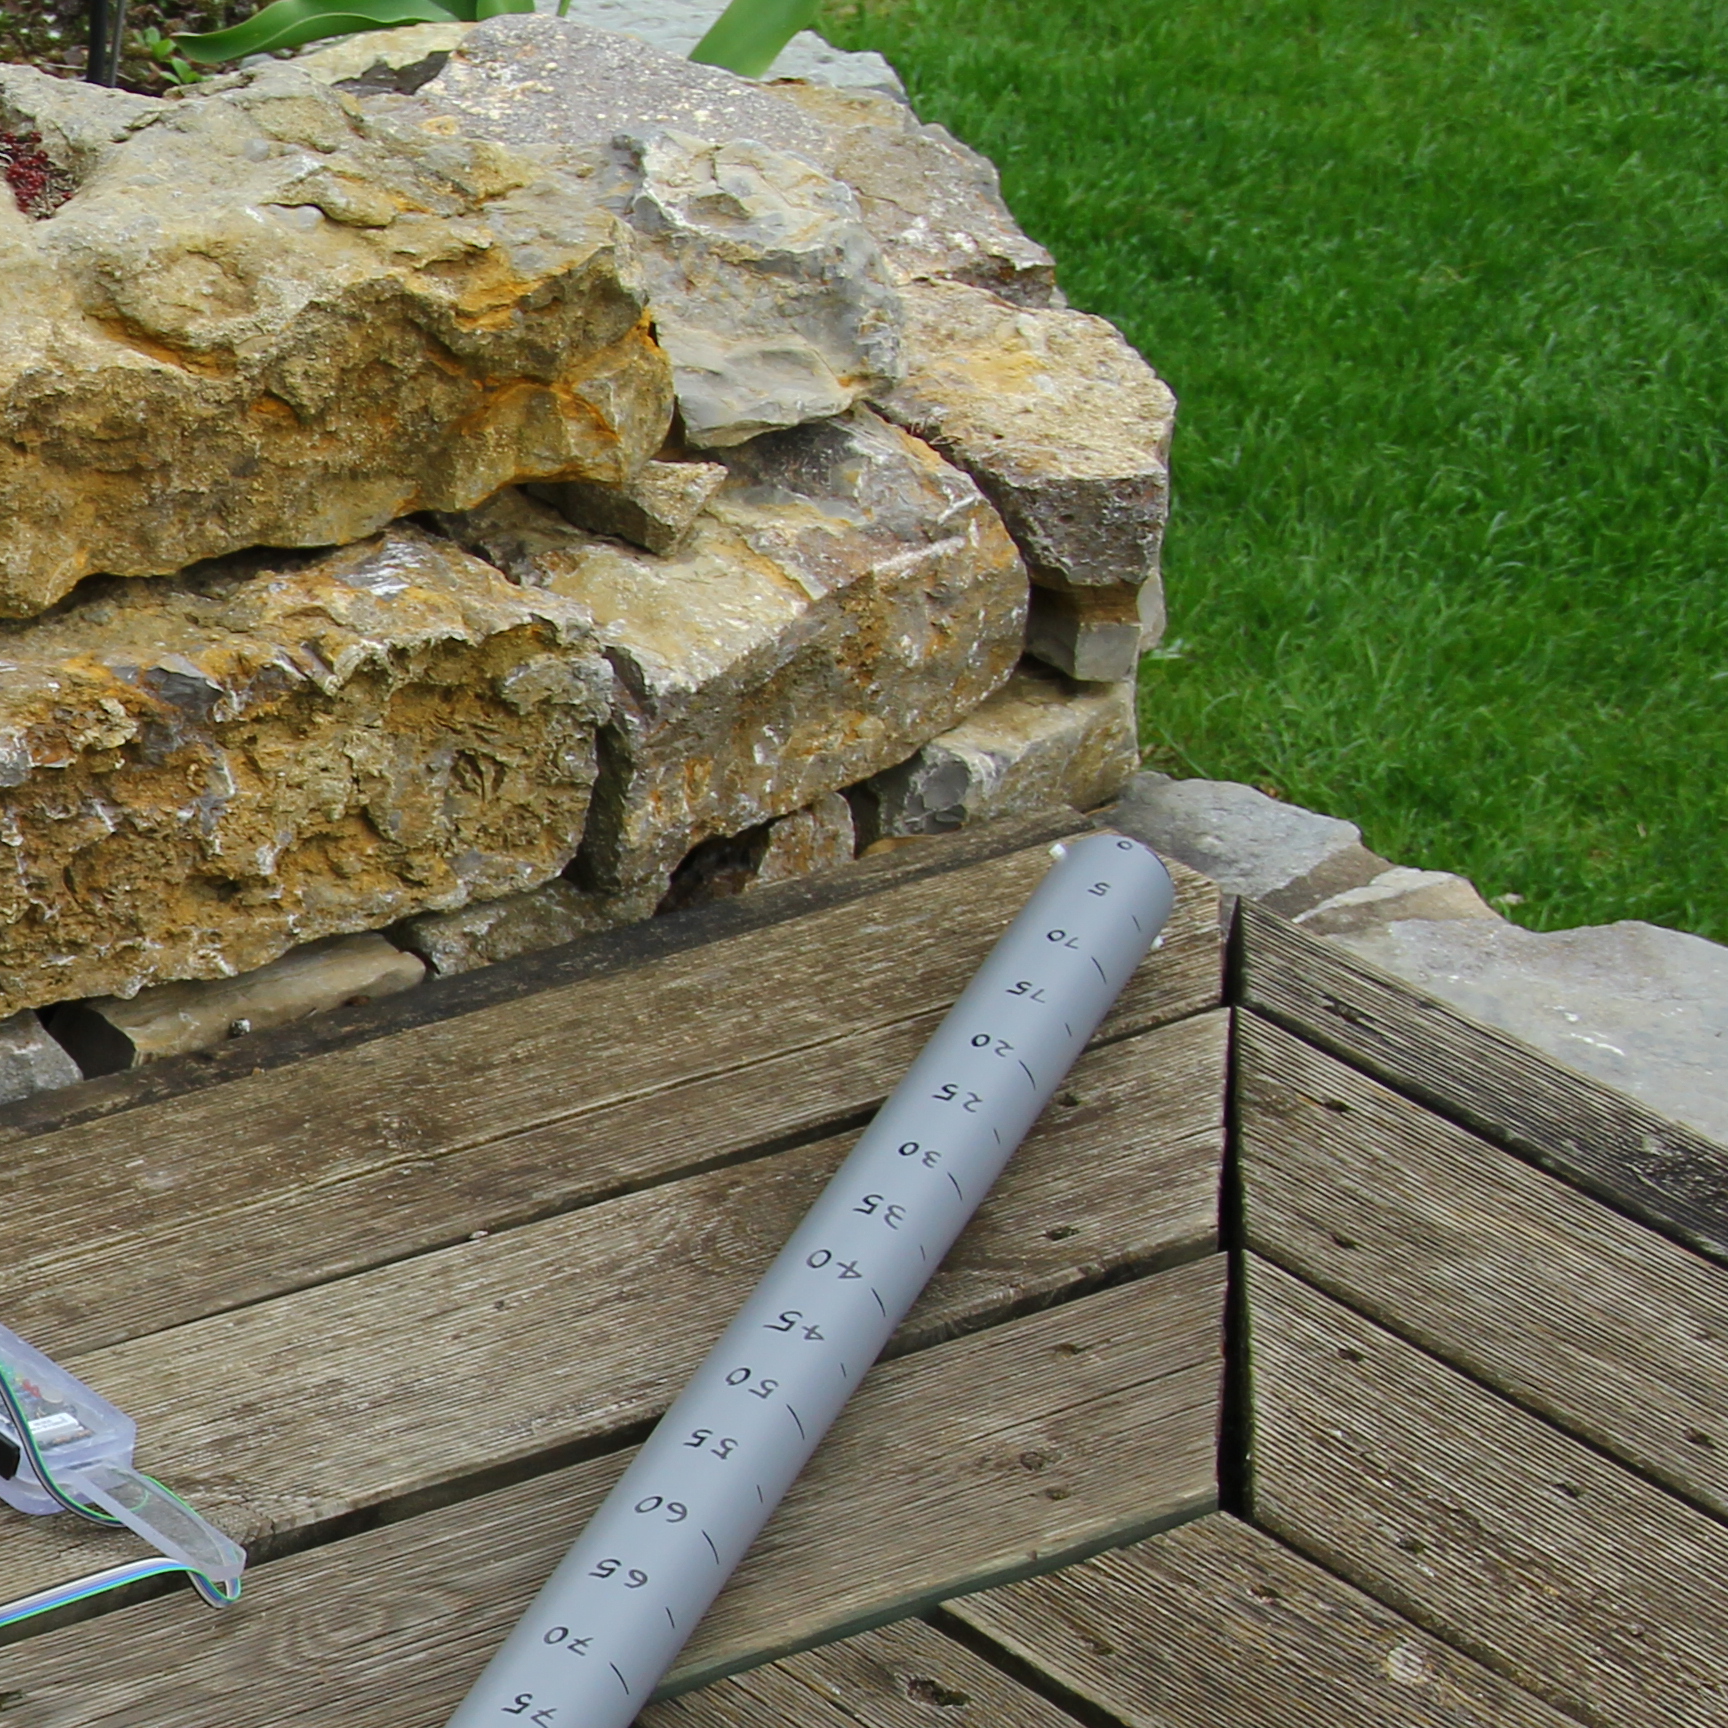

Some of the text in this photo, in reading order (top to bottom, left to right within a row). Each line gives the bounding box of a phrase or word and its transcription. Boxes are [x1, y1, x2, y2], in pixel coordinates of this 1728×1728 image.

[1116, 840, 1133, 850] 0
[1087, 882, 1110, 897] 5
[971, 1034, 1013, 1057] 20
[932, 1083, 982, 1113] 25
[898, 1141, 940, 1167] 30
[853, 1194, 905, 1229] 35
[807, 1249, 862, 1279] 40
[764, 1310, 824, 1340] 45
[725, 1367, 778, 1399] 50
[684, 1429, 738, 1460] 55
[634, 1496, 688, 1523] 60
[589, 1558, 648, 1589] 65
[544, 1626, 593, 1656] 70
